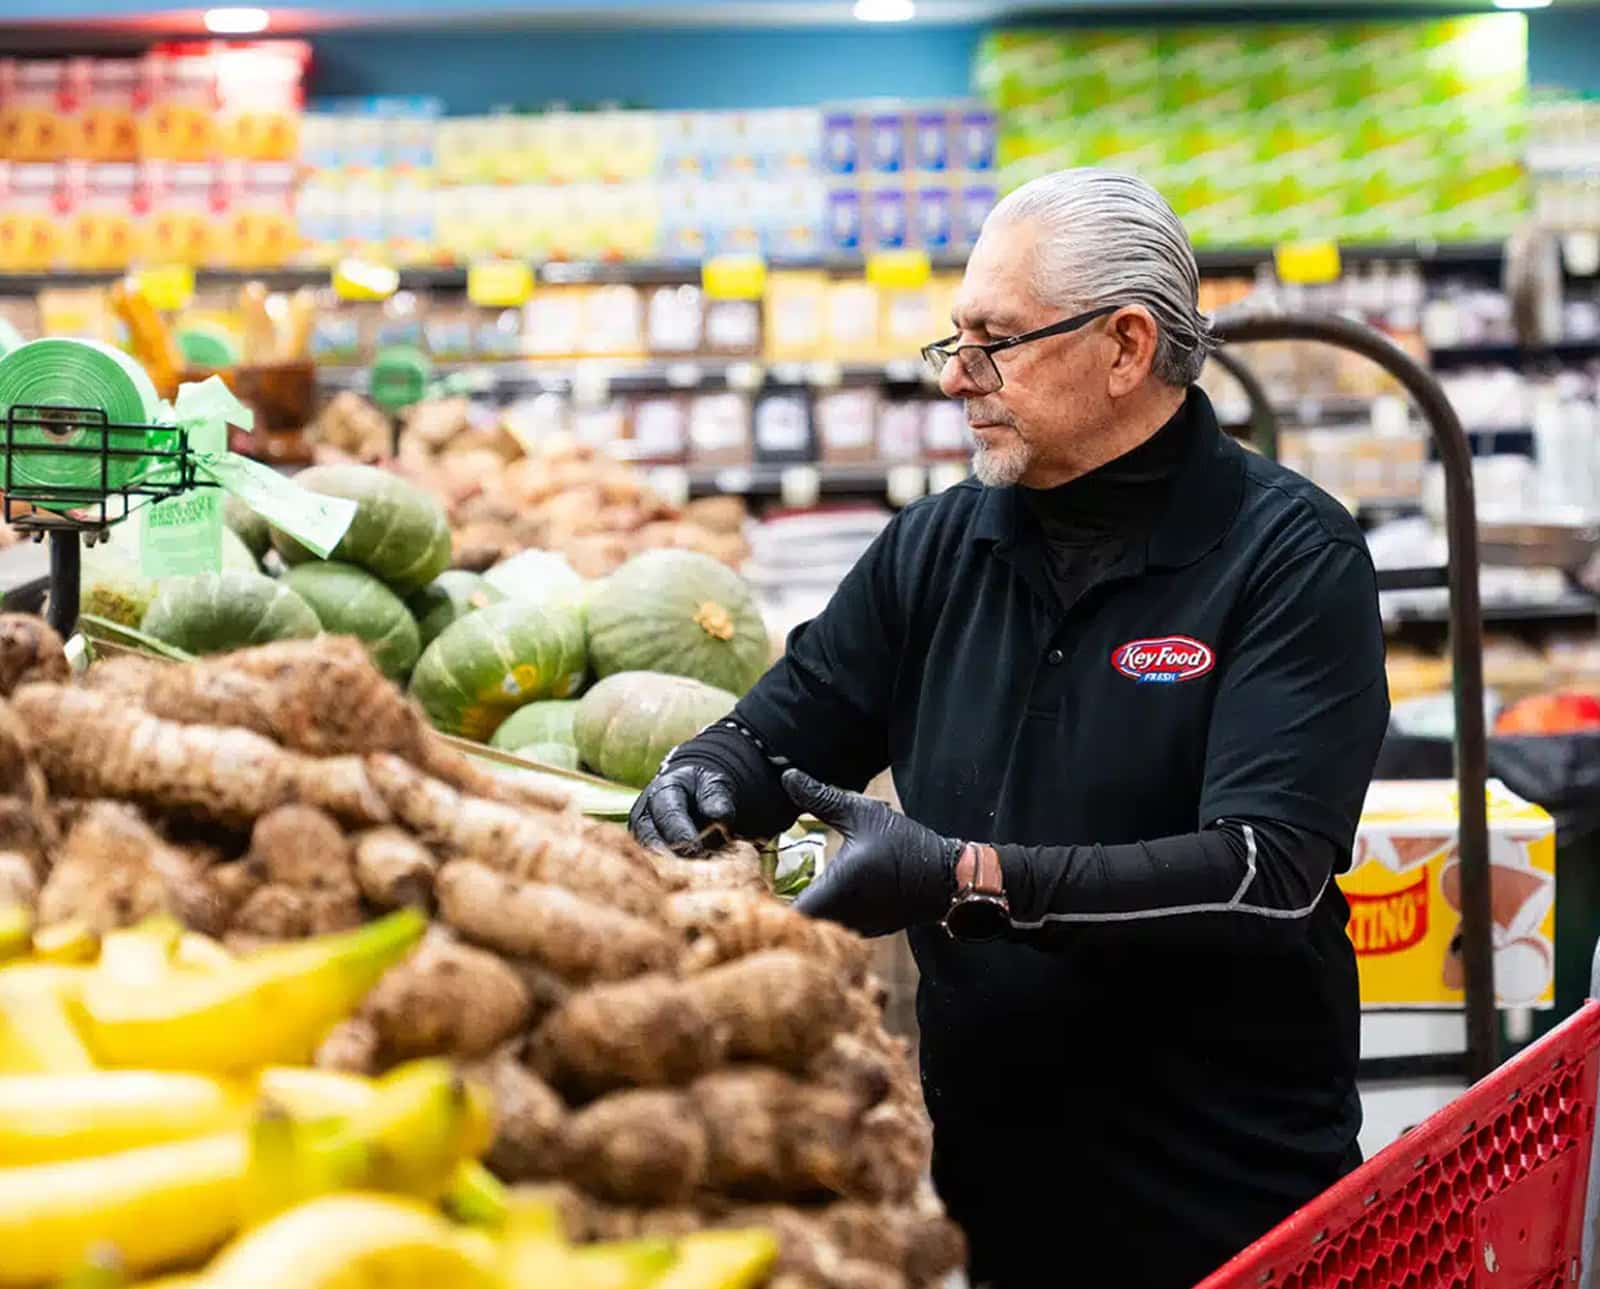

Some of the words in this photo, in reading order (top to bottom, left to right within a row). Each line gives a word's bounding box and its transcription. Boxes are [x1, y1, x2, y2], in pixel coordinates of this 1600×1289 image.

[1120, 647, 1157, 670] Key
[1156, 647, 1202, 666] Food
[1345, 893, 1417, 950] TINO
